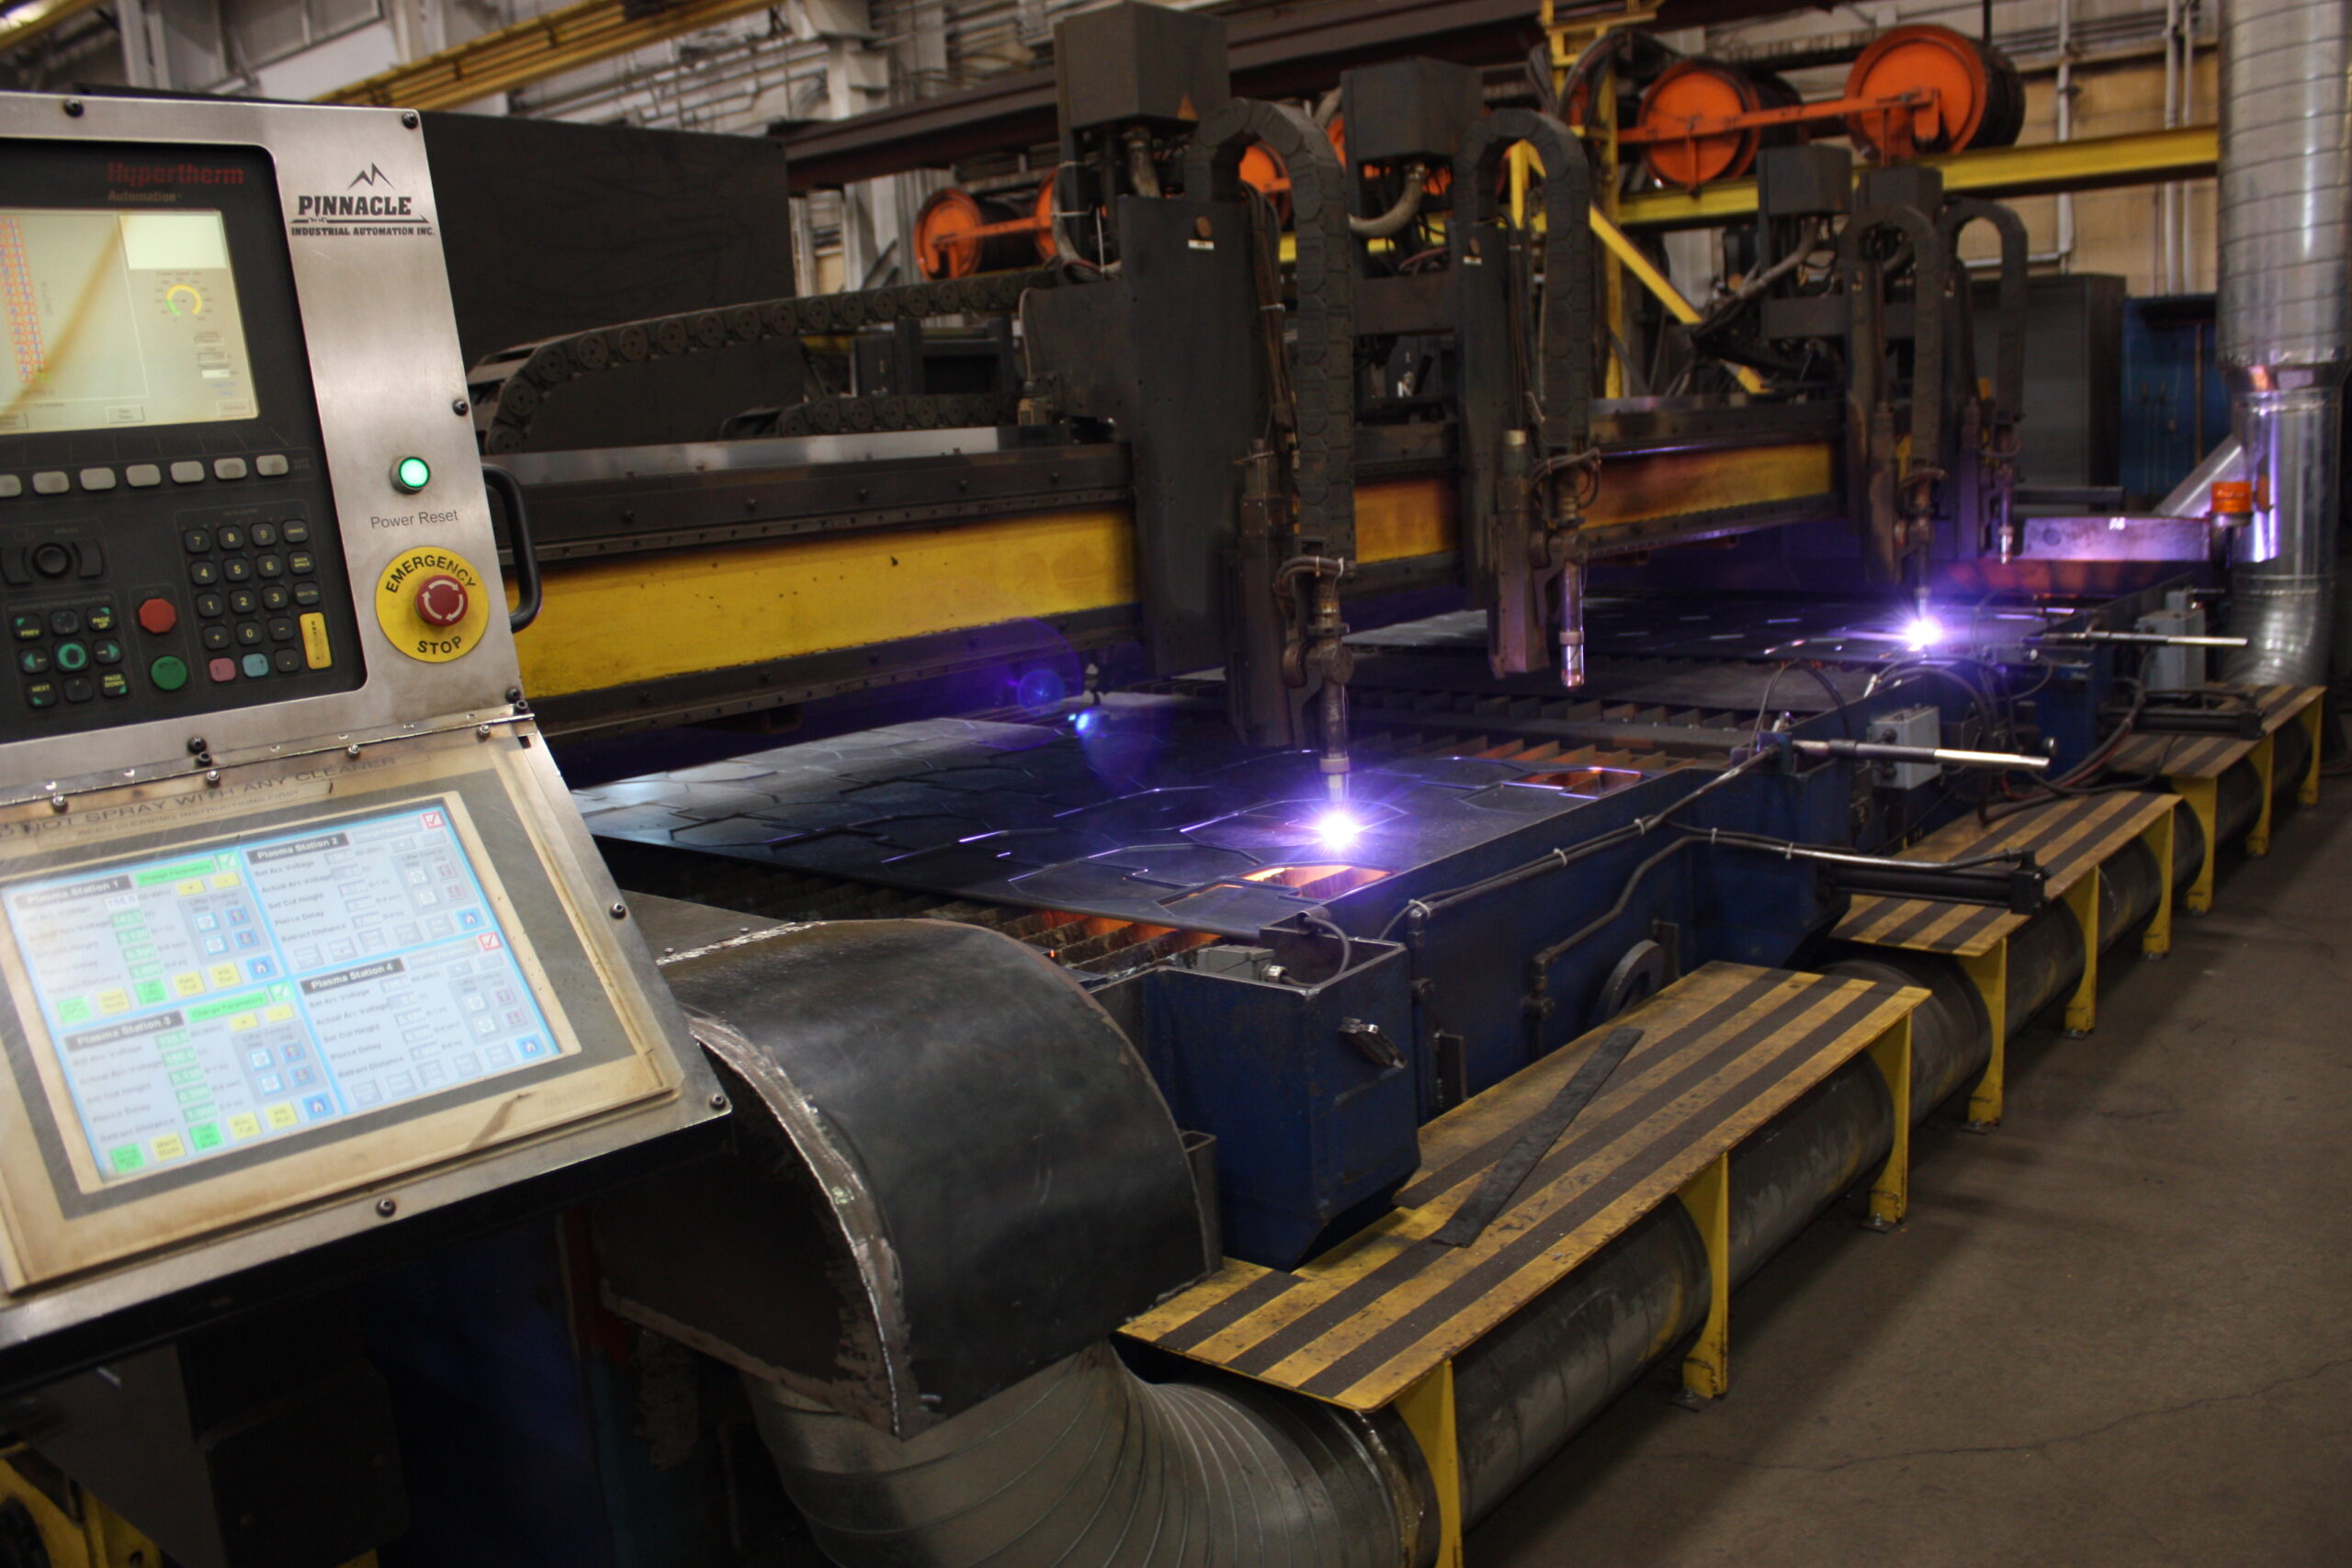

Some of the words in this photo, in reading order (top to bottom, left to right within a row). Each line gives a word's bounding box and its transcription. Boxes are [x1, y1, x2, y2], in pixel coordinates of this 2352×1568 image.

[107, 162, 244, 186] Hypertherm
[298, 195, 412, 216] PINNACLE
[290, 227, 350, 236] INDUSTRIAL
[353, 227, 414, 236] AUTOMATION
[416, 227, 435, 236] INC.
[370, 515, 414, 529] Power
[418, 509, 459, 525] Reset
[194, 536, 201, 545] 7
[228, 533, 235, 543] 8
[260, 530, 267, 538] 9
[200, 569, 209, 578] 4
[234, 565, 242, 574] 5
[266, 562, 274, 570] 6
[385, 555, 476, 593] EMERGENCY
[208, 602, 213, 610] 1
[240, 597, 248, 606] 2
[273, 593, 279, 602] 3
[246, 629, 253, 637] 0
[417, 635, 462, 655] STOP
[85, 800, 166, 822] SPRAY
[175, 785, 235, 806] WITH
[243, 775, 287, 794] ANY
[295, 756, 397, 782] CLEANER
[258, 847, 296, 860] Plasma
[297, 840, 329, 852] Station
[71, 884, 110, 897] Station
[311, 976, 349, 990] Plasma
[350, 968, 385, 983] Station
[76, 1030, 121, 1045] Plasma
[121, 1021, 162, 1035] Station
